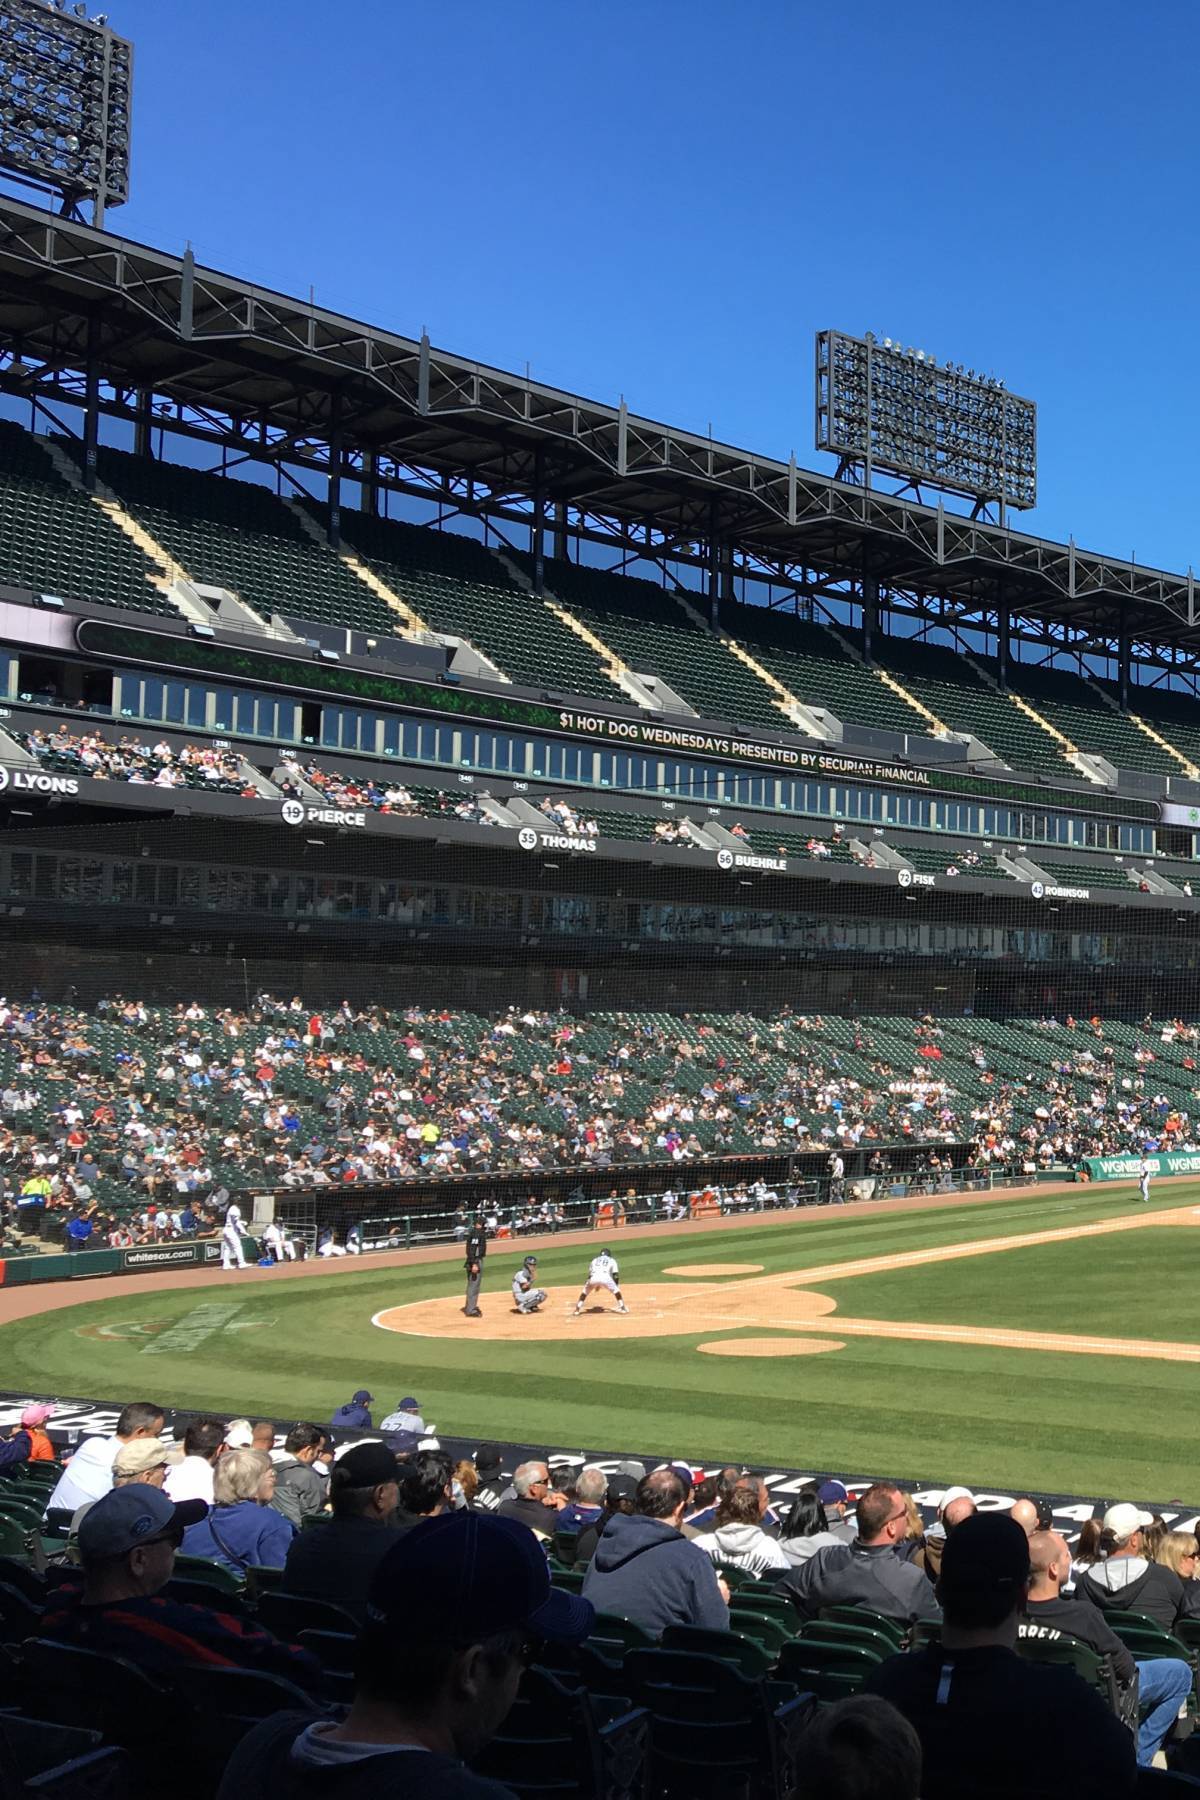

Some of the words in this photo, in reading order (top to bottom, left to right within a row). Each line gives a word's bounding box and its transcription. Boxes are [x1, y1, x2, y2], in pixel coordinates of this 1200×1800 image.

[559, 712, 574, 728] $1
[577, 716, 605, 732] HOT
[608, 722, 638, 738] DOG
[641, 727, 729, 753] WEDNESDAYS
[732, 742, 798, 764] PRESENTED
[801, 753, 816, 767] BY
[818, 756, 873, 776] SECURIAN
[875, 765, 930, 784] FINANCIAL
[14, 772, 78, 794] LYONS
[286, 806, 300, 818] 19
[308, 808, 366, 826] PIERCE
[522, 833, 535, 843] 35
[540, 834, 597, 852] THOMAS
[720, 854, 732, 864] 56
[735, 854, 788, 871] BUEHRLE
[912, 874, 936, 886] FISK
[1034, 886, 1042, 895] 42
[1044, 886, 1090, 900] ROBINSON
[1168, 1158, 1194, 1171] WGN
[127, 1250, 193, 1264] whitesox.com
